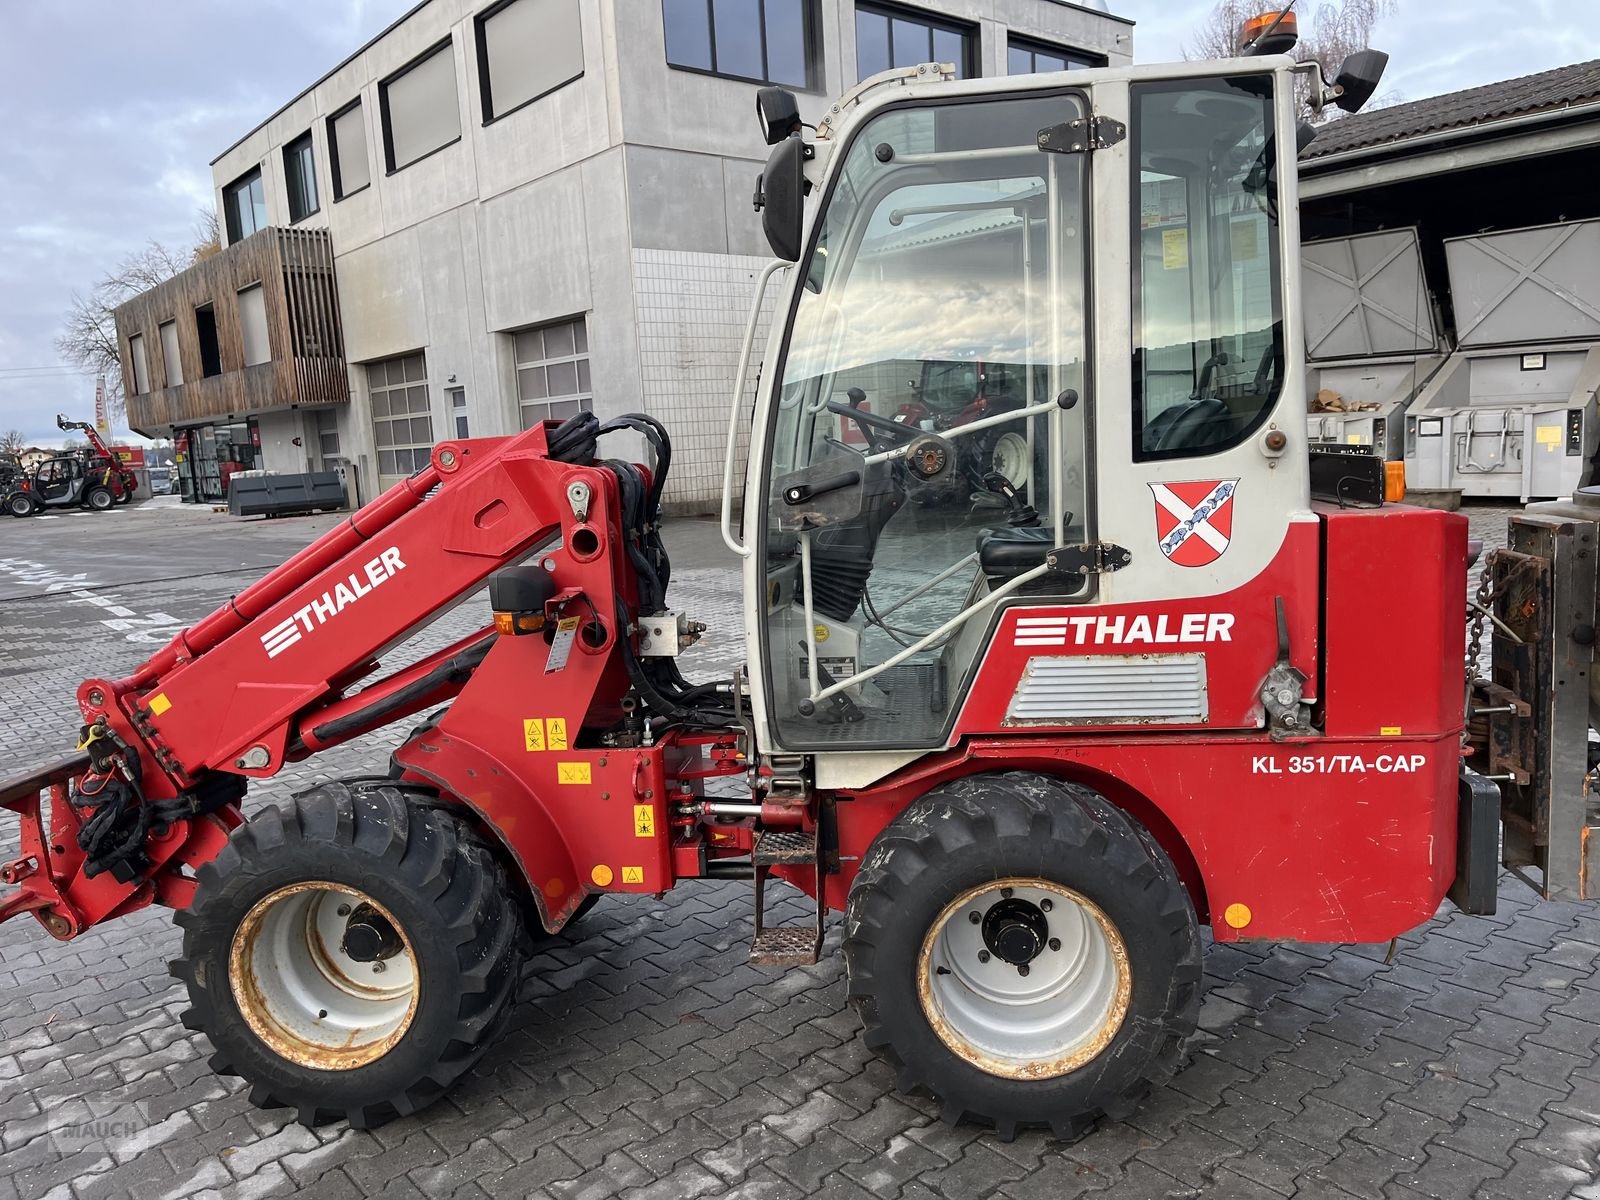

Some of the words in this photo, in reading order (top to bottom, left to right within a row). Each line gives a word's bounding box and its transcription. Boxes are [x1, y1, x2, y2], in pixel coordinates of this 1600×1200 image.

[293, 546, 407, 633] THALER
[1069, 613, 1235, 645] THALER
[1252, 756, 1282, 774] KL
[1288, 754, 1426, 774] 351/TA-CAP
